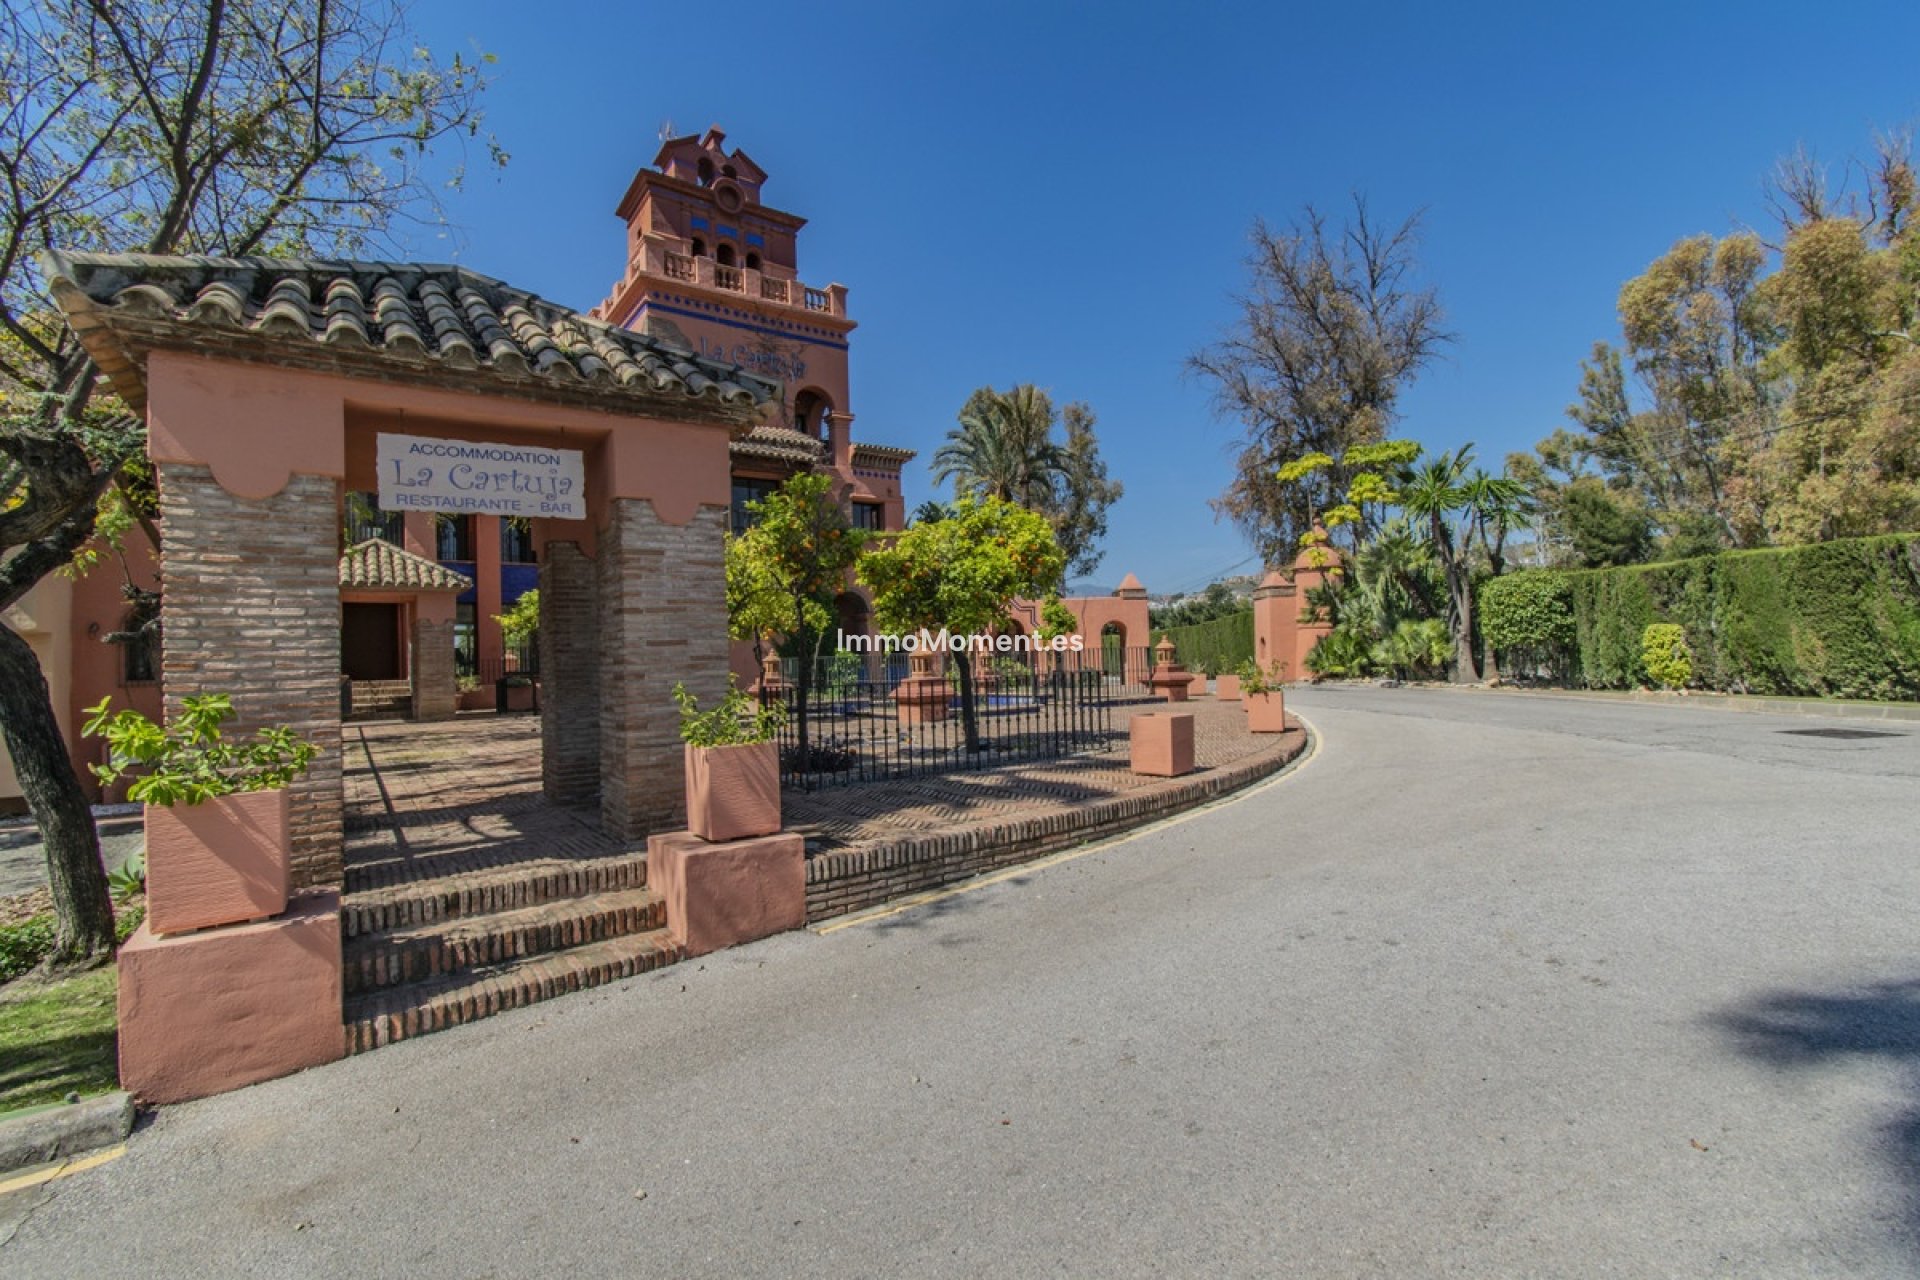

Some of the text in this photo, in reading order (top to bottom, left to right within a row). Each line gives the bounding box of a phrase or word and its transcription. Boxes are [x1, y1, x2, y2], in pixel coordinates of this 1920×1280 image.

[409, 442, 561, 466] ACCOMMODATION
[391, 458, 573, 501] La Cartuja
[395, 493, 521, 512] RESTAURANTE
[540, 501, 572, 513] BAR
